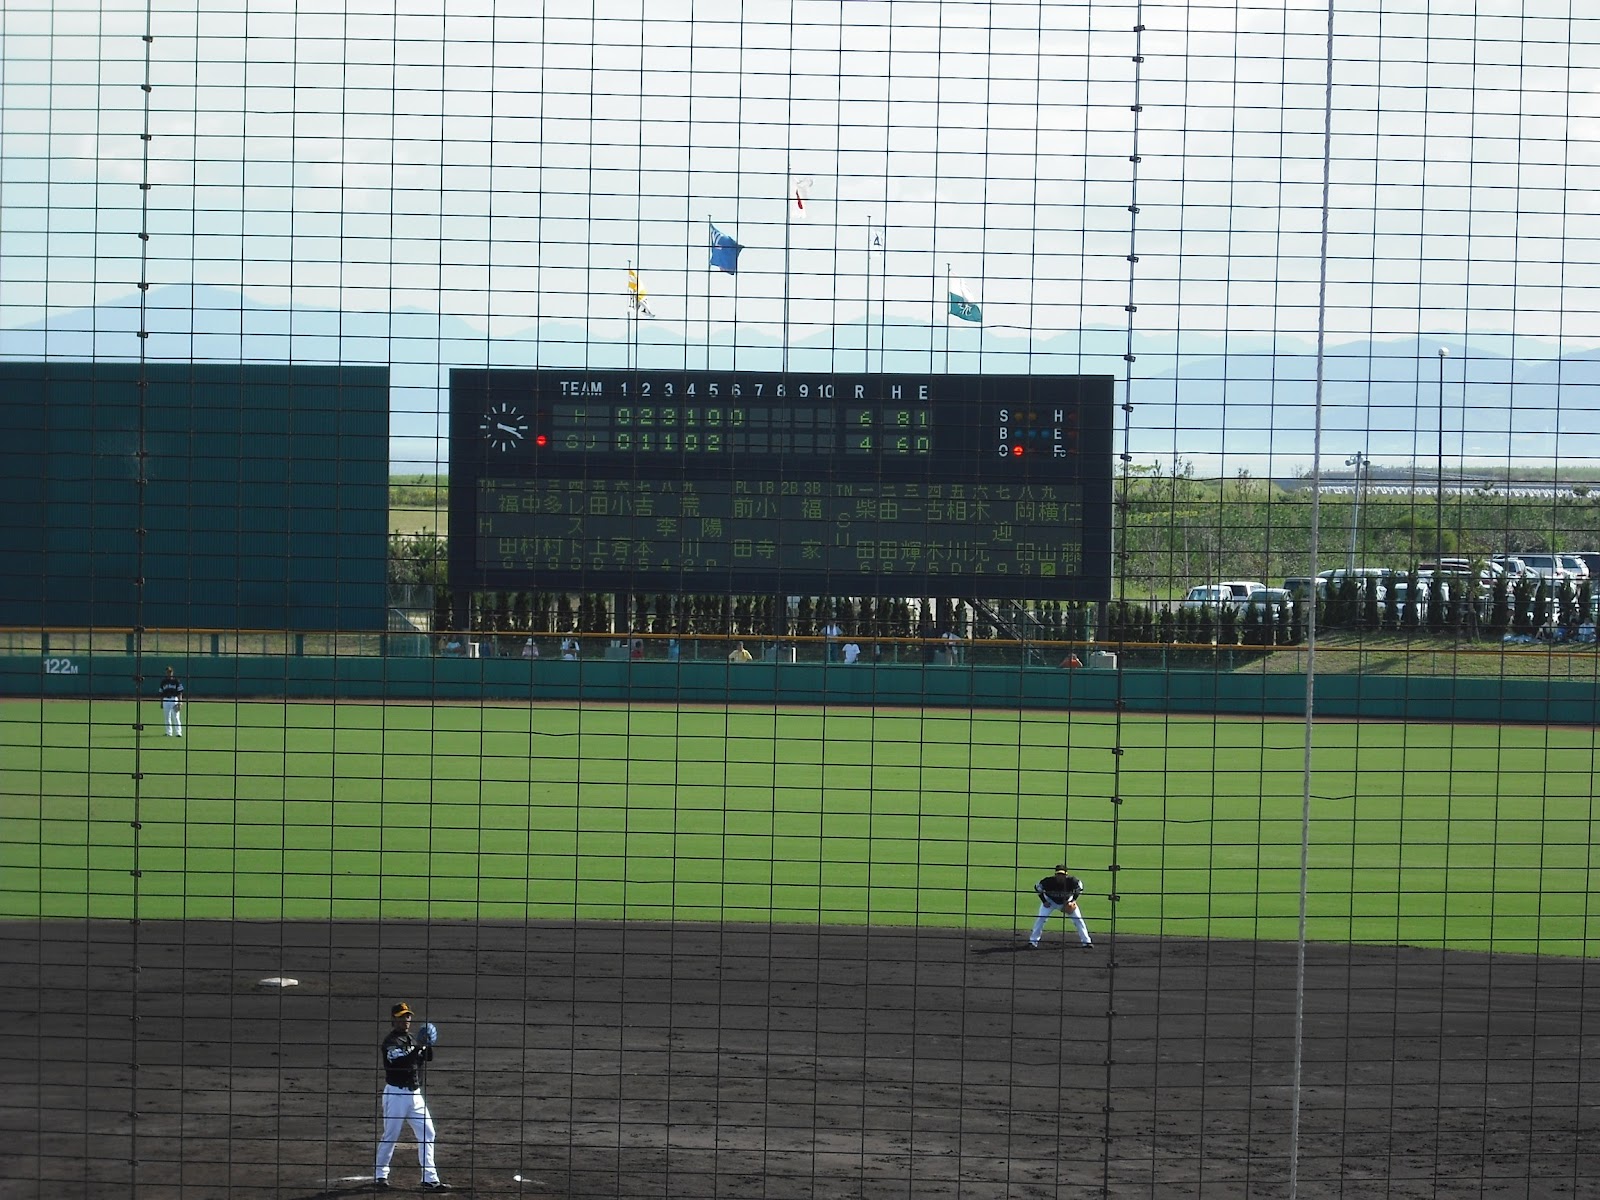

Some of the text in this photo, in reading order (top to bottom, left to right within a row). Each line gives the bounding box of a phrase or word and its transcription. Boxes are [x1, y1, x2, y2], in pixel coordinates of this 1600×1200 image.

[560, 381, 928, 400] TEAM 1 2 3 4 5 6 7 8 9 10 R H E
[574, 408, 927, 428] H 0 2 3 1 0 0 6 8 1
[1000, 409, 1009, 422] S
[1054, 409, 1063, 422] H
[1000, 427, 1008, 439] B
[1054, 428, 1062, 439] E
[618, 433, 630, 449] 0
[642, 433, 650, 450] 1
[664, 434, 672, 450] 1
[685, 434, 697, 450] 0
[708, 434, 720, 451] 2
[859, 436, 872, 452] 4
[999, 444, 1008, 457] O
[568, 481, 583, 494] 四
[735, 481, 821, 495] PL 1B 2B 3B
[927, 485, 942, 498] 四
[950, 484, 965, 499] 五
[995, 485, 1011, 499] 七
[1041, 485, 1056, 500] 九
[860, 561, 871, 574] 6
[882, 561, 893, 575] 8
[906, 562, 916, 575] 7
